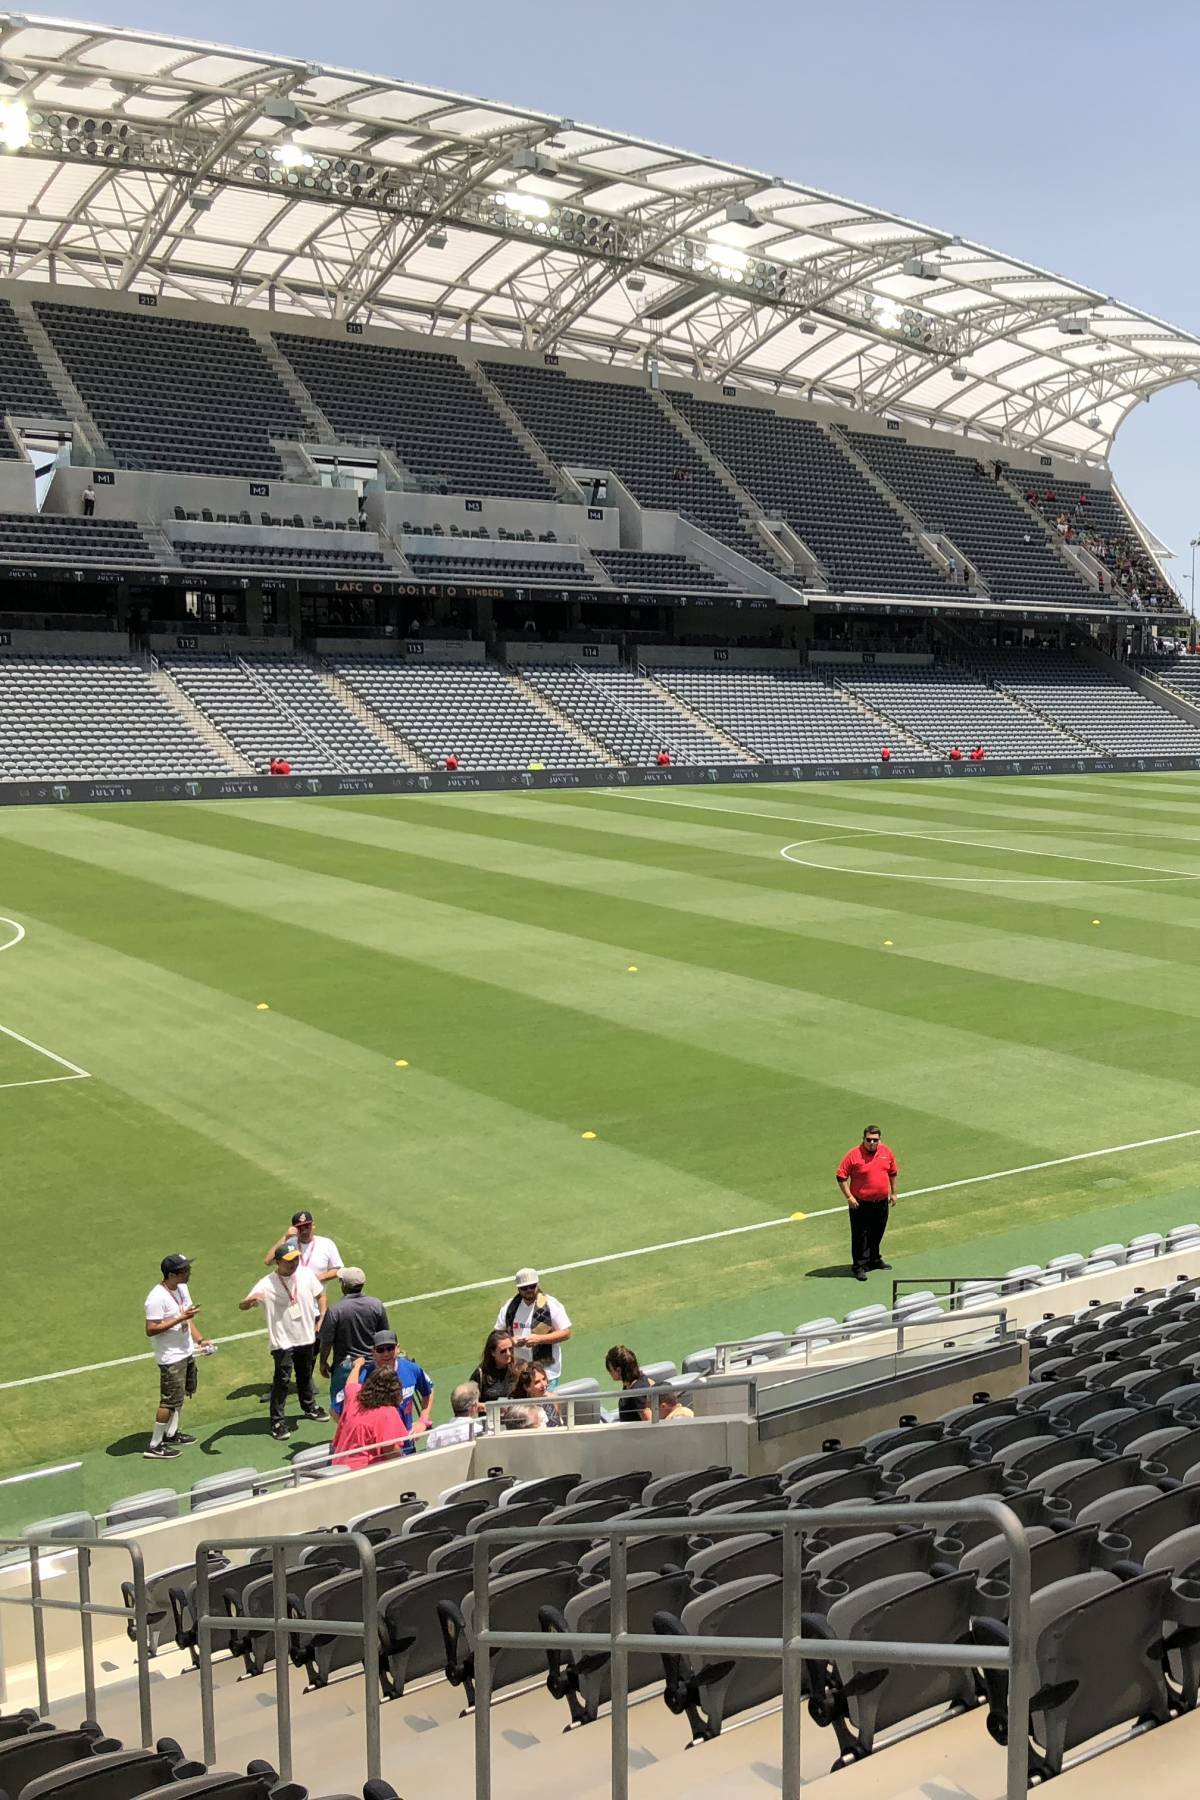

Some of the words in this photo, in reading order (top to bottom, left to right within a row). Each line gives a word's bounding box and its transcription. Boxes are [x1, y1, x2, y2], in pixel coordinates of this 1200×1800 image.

[141, 296, 156, 305] 212
[348, 324, 360, 333] 213
[98, 475, 110, 483] M1
[335, 582, 363, 592] LAFC
[399, 585, 437, 595] 60:14
[466, 588, 505, 598] TIMBERS
[181, 639, 196, 648] 112
[409, 645, 422, 653] 113
[585, 648, 597, 656] 114
[549, 776, 567, 784] JULY
[90, 789, 115, 797] JULY
[220, 785, 243, 793] JULY
